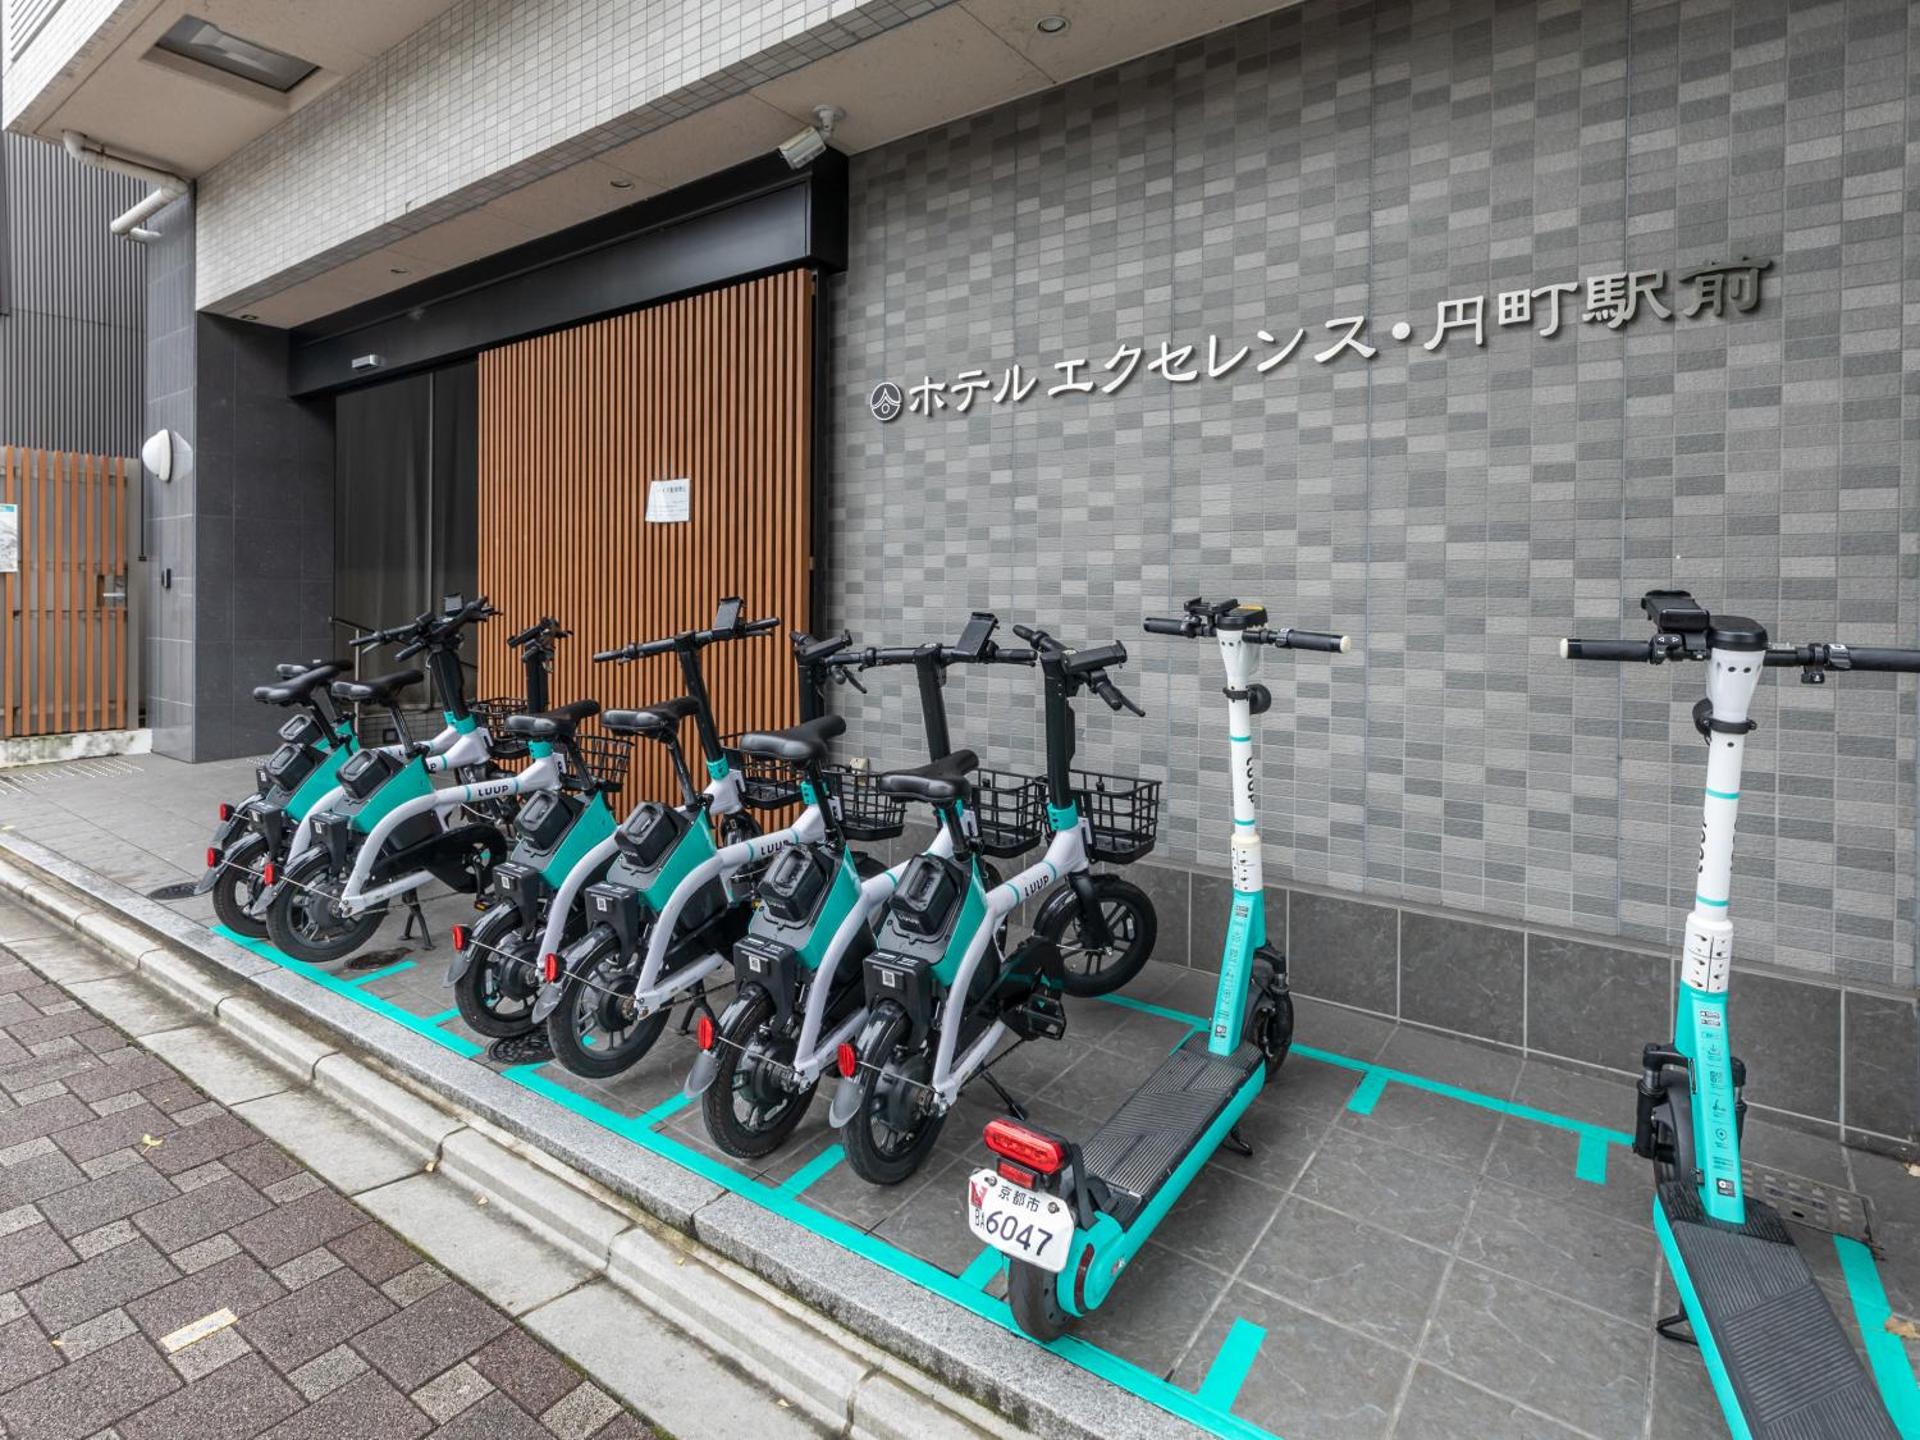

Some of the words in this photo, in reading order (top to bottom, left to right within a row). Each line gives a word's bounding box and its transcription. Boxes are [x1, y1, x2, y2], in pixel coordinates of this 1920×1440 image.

[478, 784, 509, 797] LUUP
[1024, 874, 1049, 897] LUUP
[998, 1185, 1041, 1212] 京都市
[986, 1210, 1053, 1256] 6047
